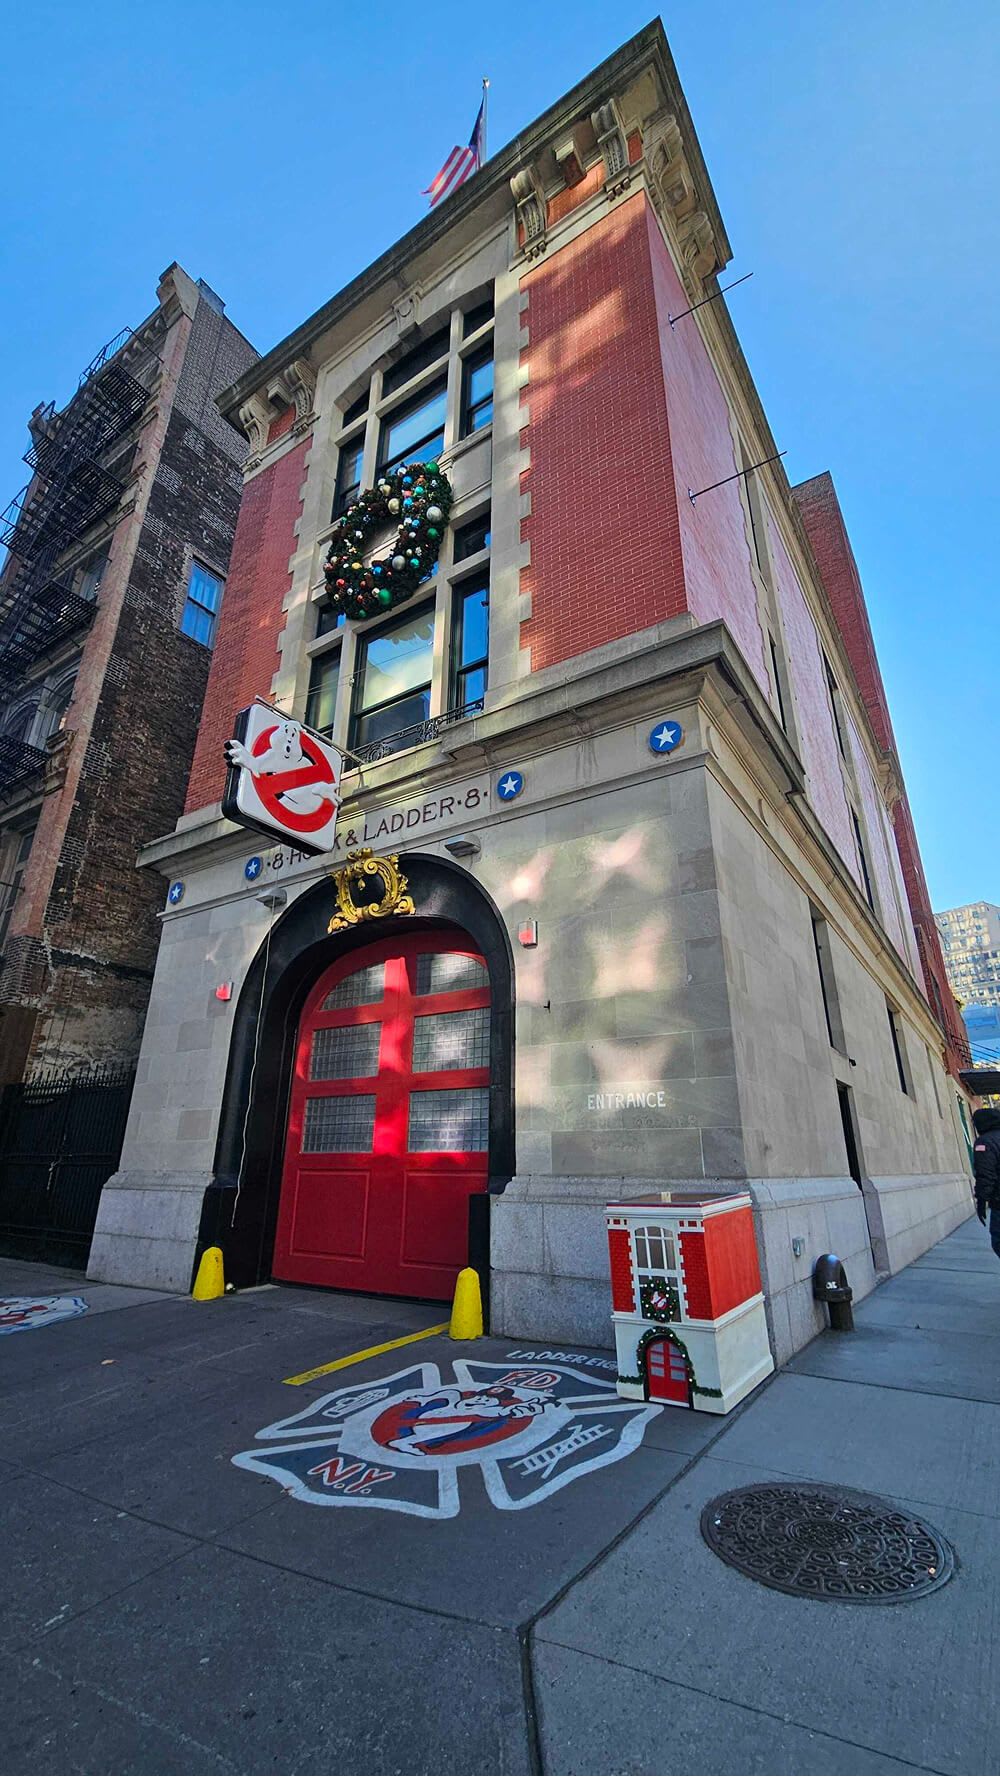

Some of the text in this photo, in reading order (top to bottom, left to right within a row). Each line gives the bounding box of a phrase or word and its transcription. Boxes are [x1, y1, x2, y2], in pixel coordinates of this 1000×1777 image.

[290, 833, 341, 865] HK
[346, 828, 358, 847] &
[587, 1091, 667, 1110] ENTRANCE
[506, 1350, 588, 1364] LADDER
[307, 1457, 396, 1494] N.Y.
